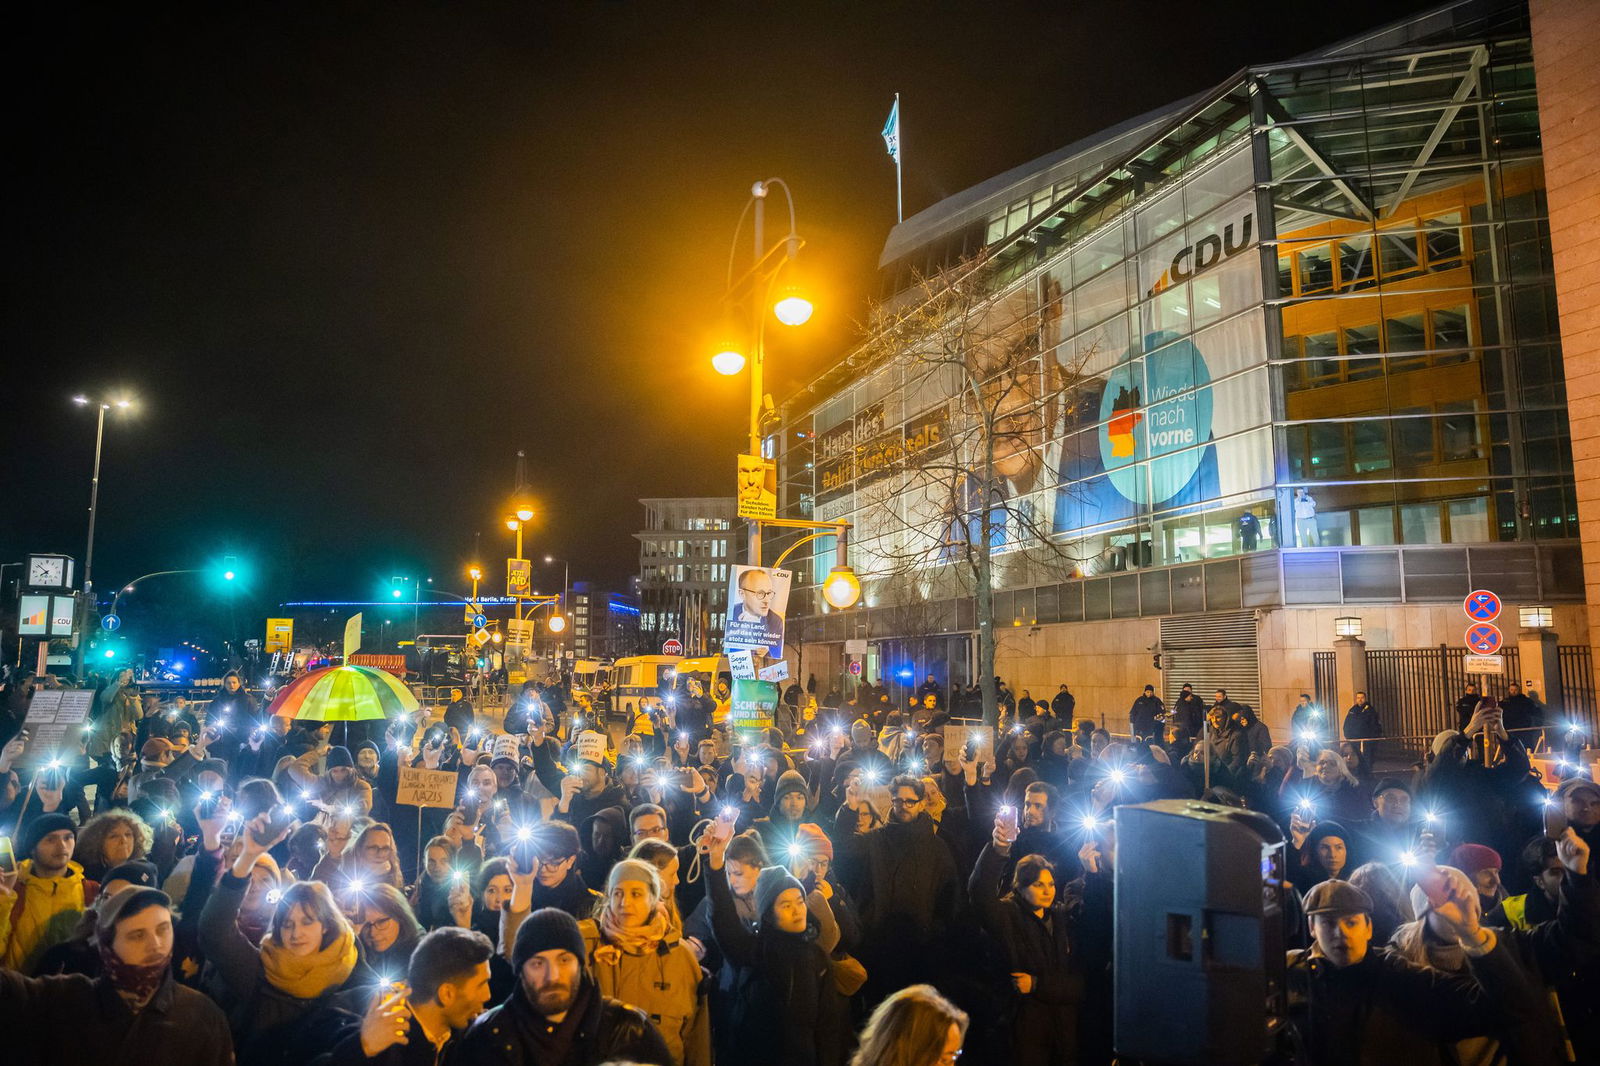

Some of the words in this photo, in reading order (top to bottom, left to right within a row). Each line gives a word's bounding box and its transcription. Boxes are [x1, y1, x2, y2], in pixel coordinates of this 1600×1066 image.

[1170, 213, 1253, 284] CDU
[1151, 405, 1185, 427] nach
[823, 431, 853, 457] Haus
[856, 416, 880, 442] des
[1150, 426, 1195, 448] vorne
[822, 424, 940, 490] Politkwechsels
[510, 576, 526, 585] AfD
[751, 623, 768, 632] Land,
[763, 631, 782, 639] wieder
[728, 635, 743, 643] stolz
[757, 638, 778, 646] können.
[665, 645, 681, 653] STOP
[731, 654, 748, 664] Sogar
[734, 701, 774, 711] SCHULEN
[734, 711, 750, 719] UND
[412, 789, 442, 803] NAZIS
